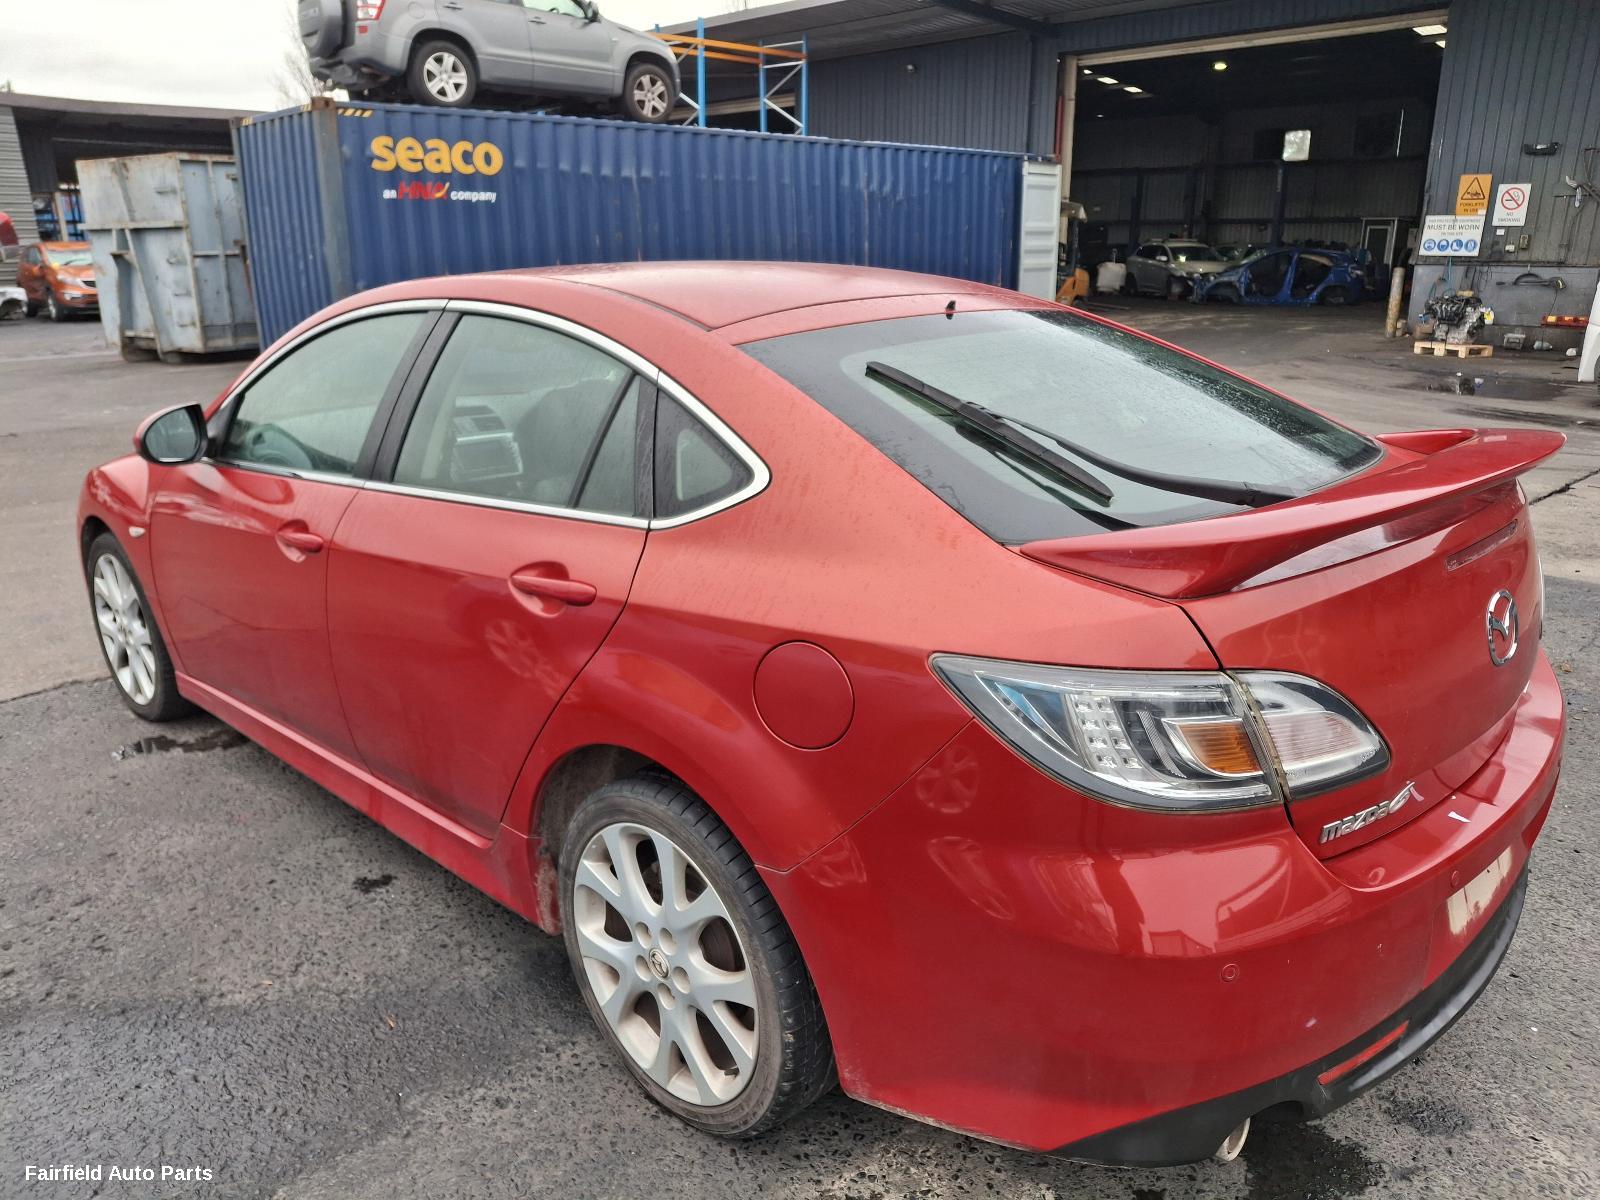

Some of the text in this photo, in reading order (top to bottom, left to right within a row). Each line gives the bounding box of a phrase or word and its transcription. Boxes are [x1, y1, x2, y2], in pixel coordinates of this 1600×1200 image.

[370, 135, 504, 176] seaco
[383, 189, 397, 199] an
[450, 190, 497, 203] company
